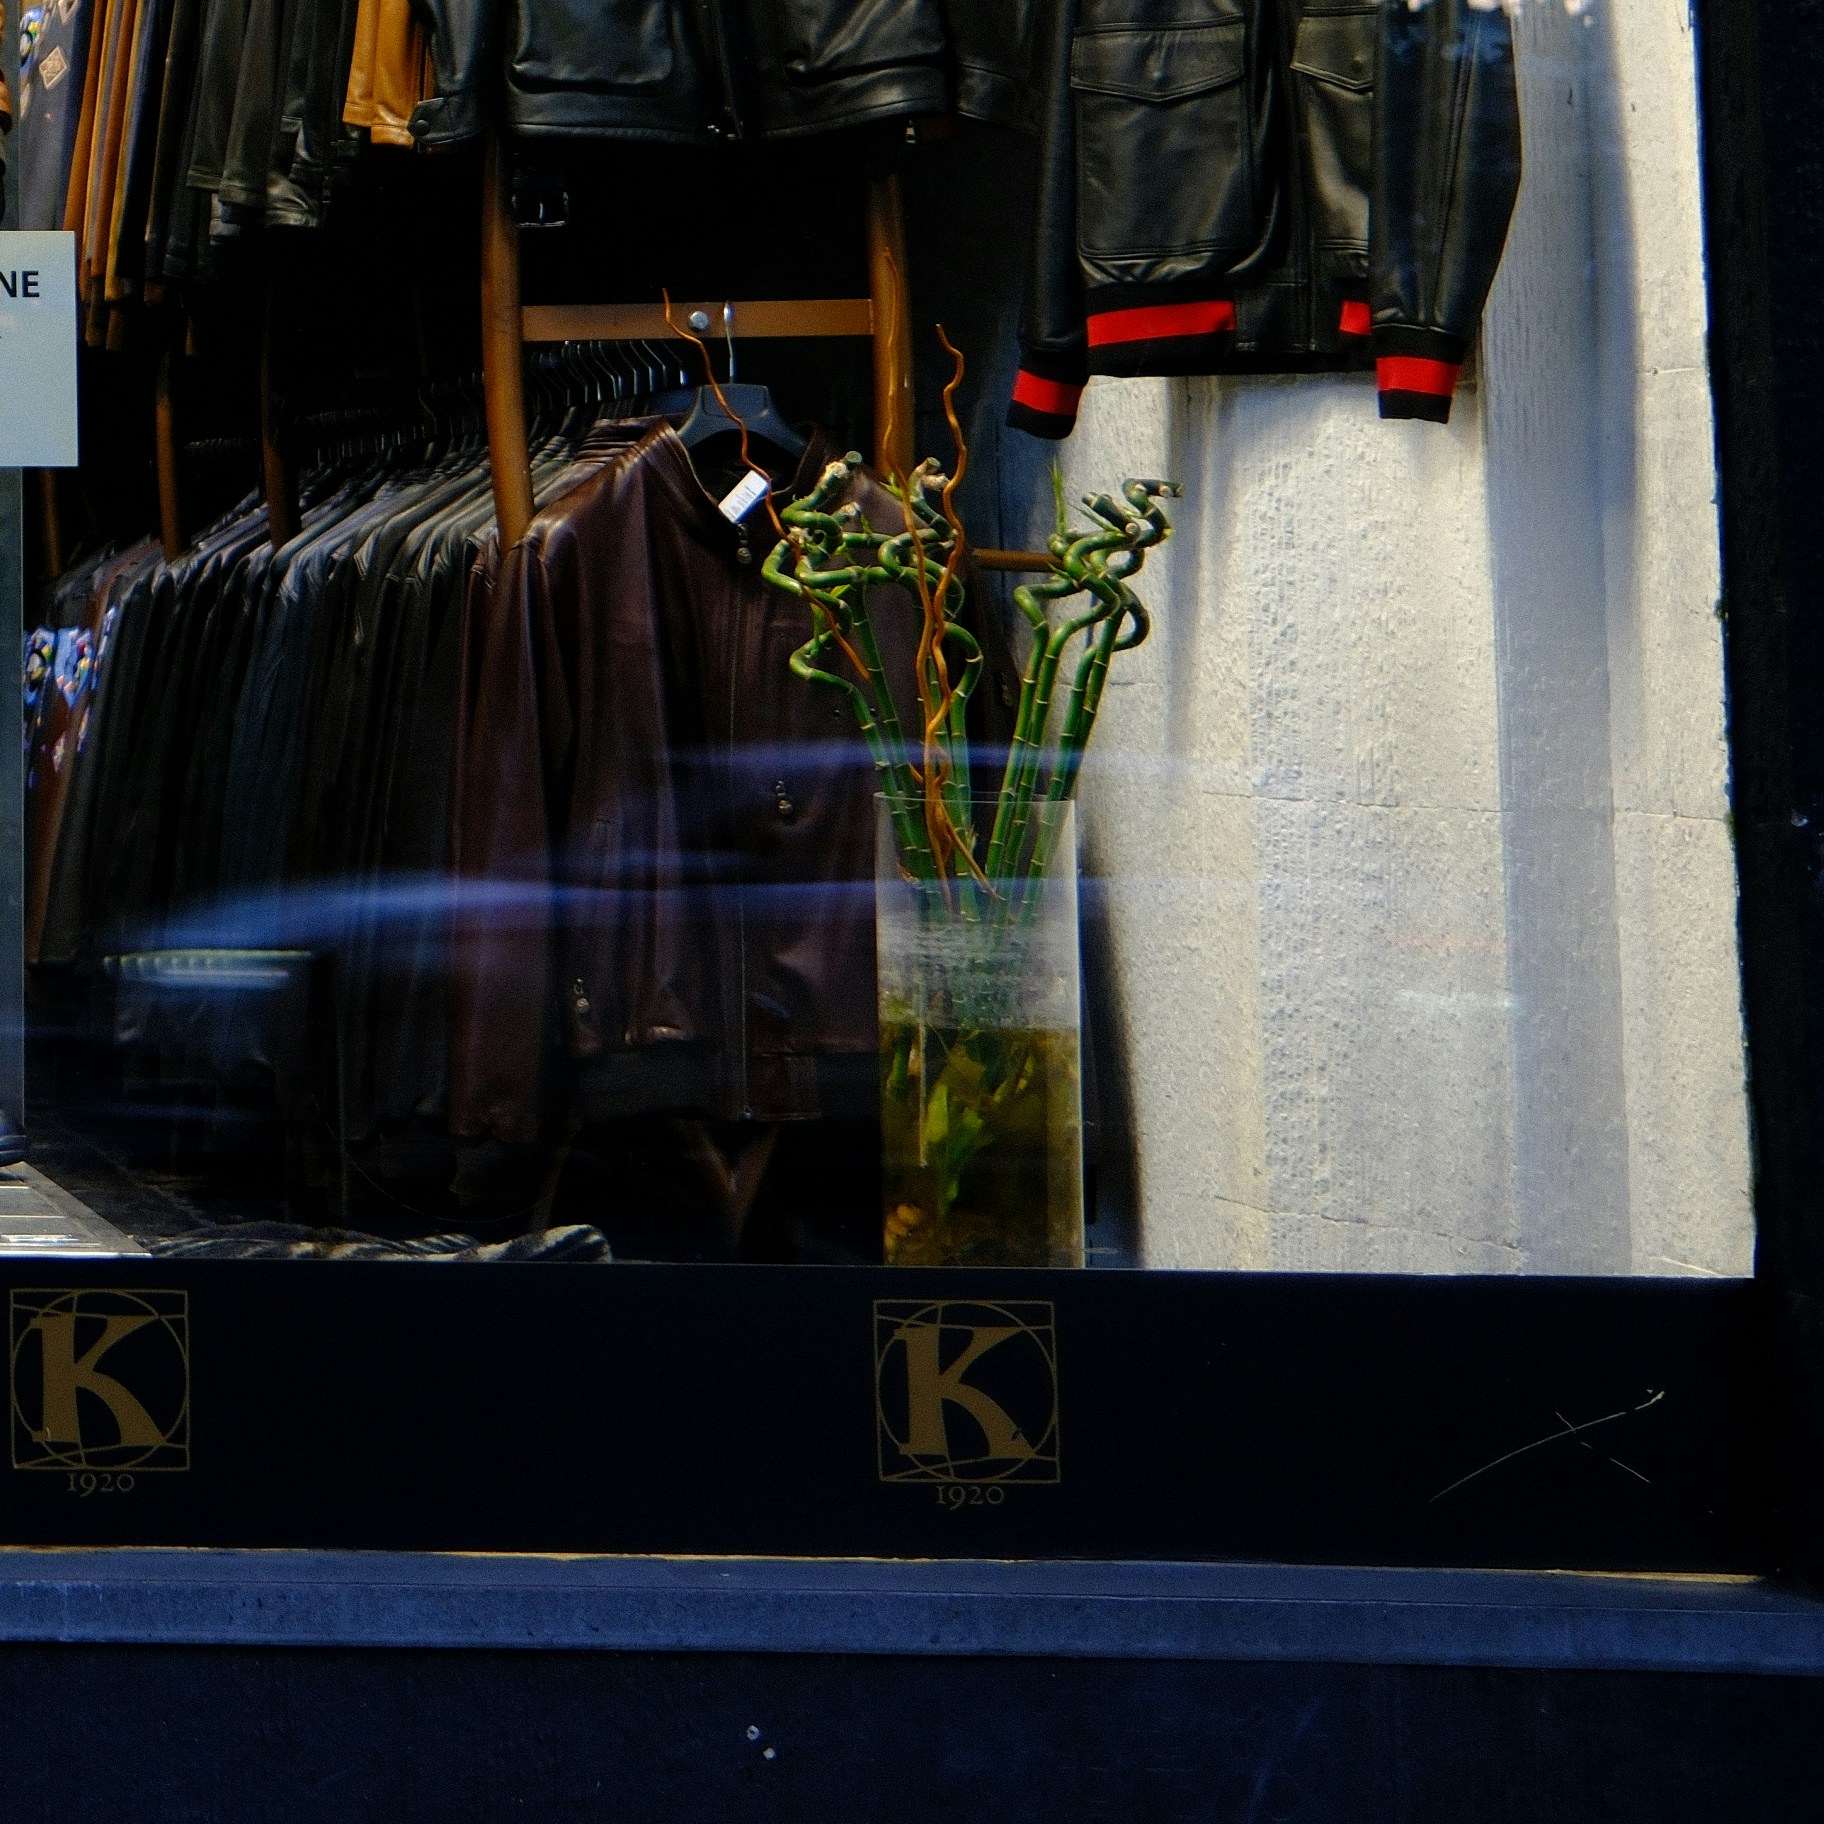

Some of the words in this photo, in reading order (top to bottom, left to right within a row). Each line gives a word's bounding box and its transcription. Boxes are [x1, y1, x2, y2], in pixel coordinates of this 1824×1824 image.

[30, 1313, 167, 1445] K
[894, 1326, 1037, 1458] K
[67, 1473, 135, 1497] 1920
[936, 1485, 1005, 1510] 1920
